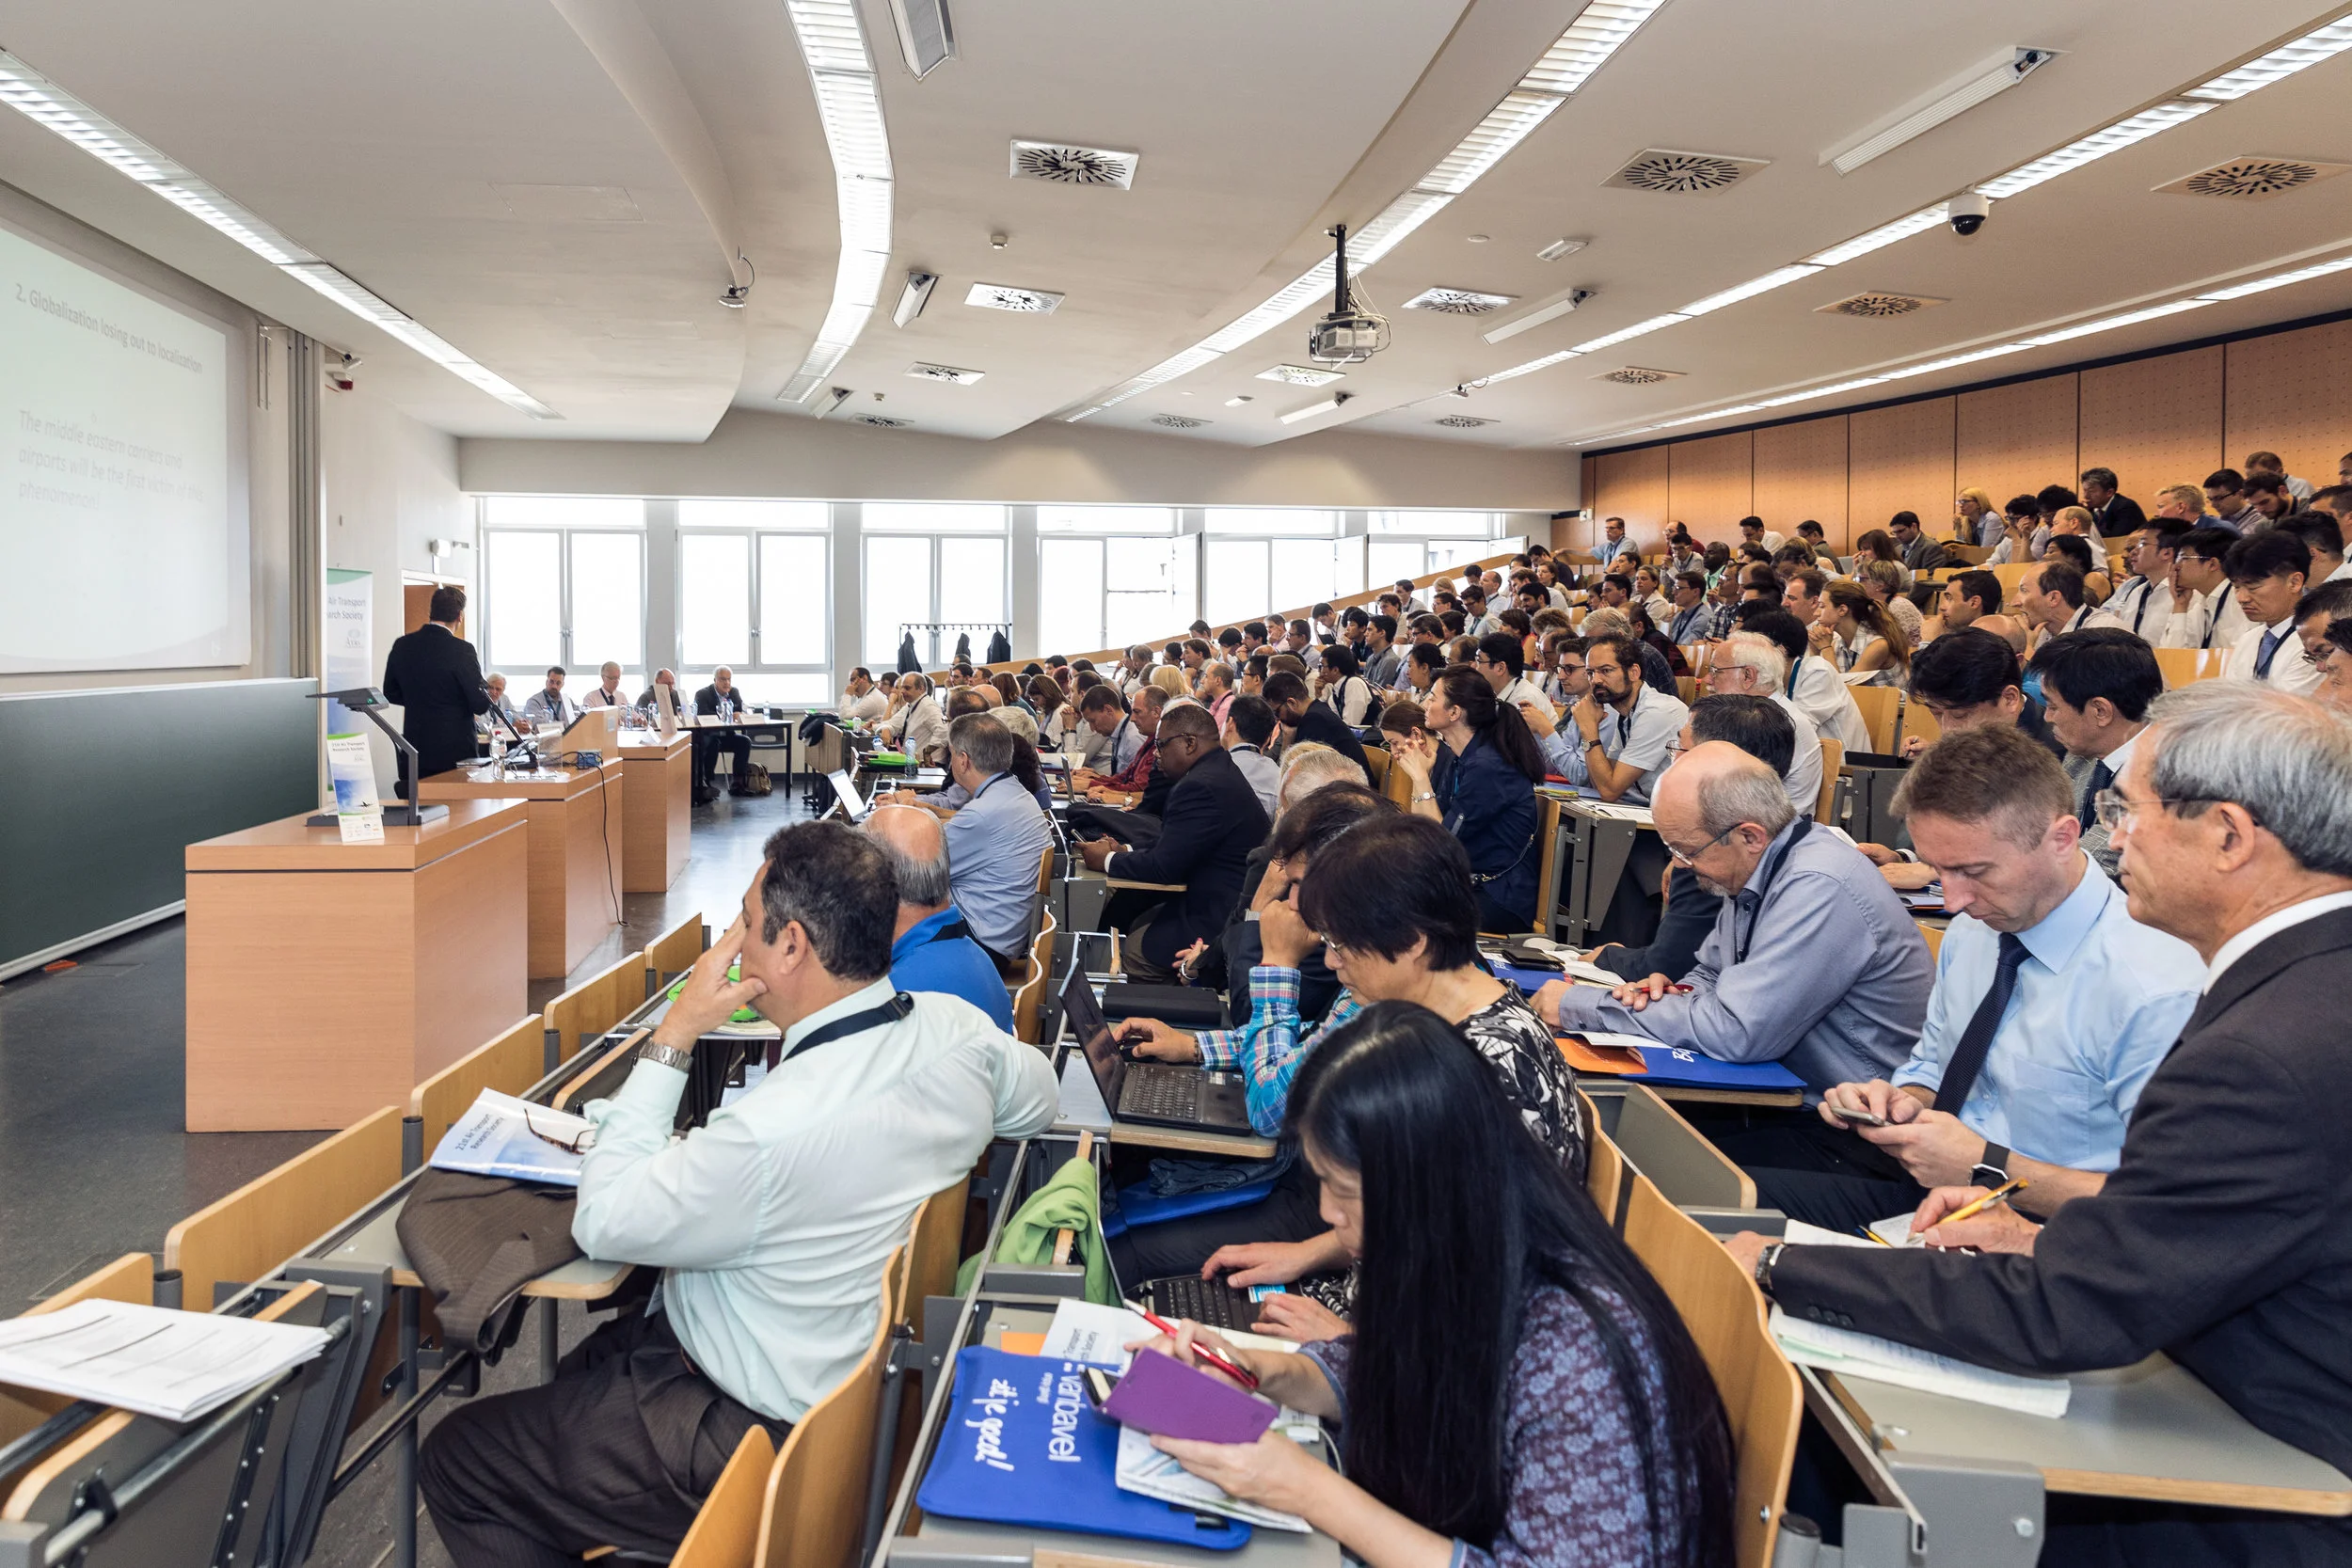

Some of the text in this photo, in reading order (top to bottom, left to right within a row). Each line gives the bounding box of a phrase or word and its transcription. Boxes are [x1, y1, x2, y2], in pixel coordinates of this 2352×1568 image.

[15, 282, 202, 374] 2. Globalization losing out to localization
[19, 409, 40, 434] The
[44, 419, 84, 444] middle
[87, 431, 126, 454] eastern
[127, 441, 163, 466] carriers
[19, 446, 66, 473] airports
[70, 456, 88, 477] will
[91, 460, 104, 480] be
[107, 467, 123, 484] the
[125, 468, 145, 490] first
[326, 609, 340, 619] arch
[964, 1378, 1019, 1472] zit je goed!
[1048, 1374, 1087, 1463] vanbavel
